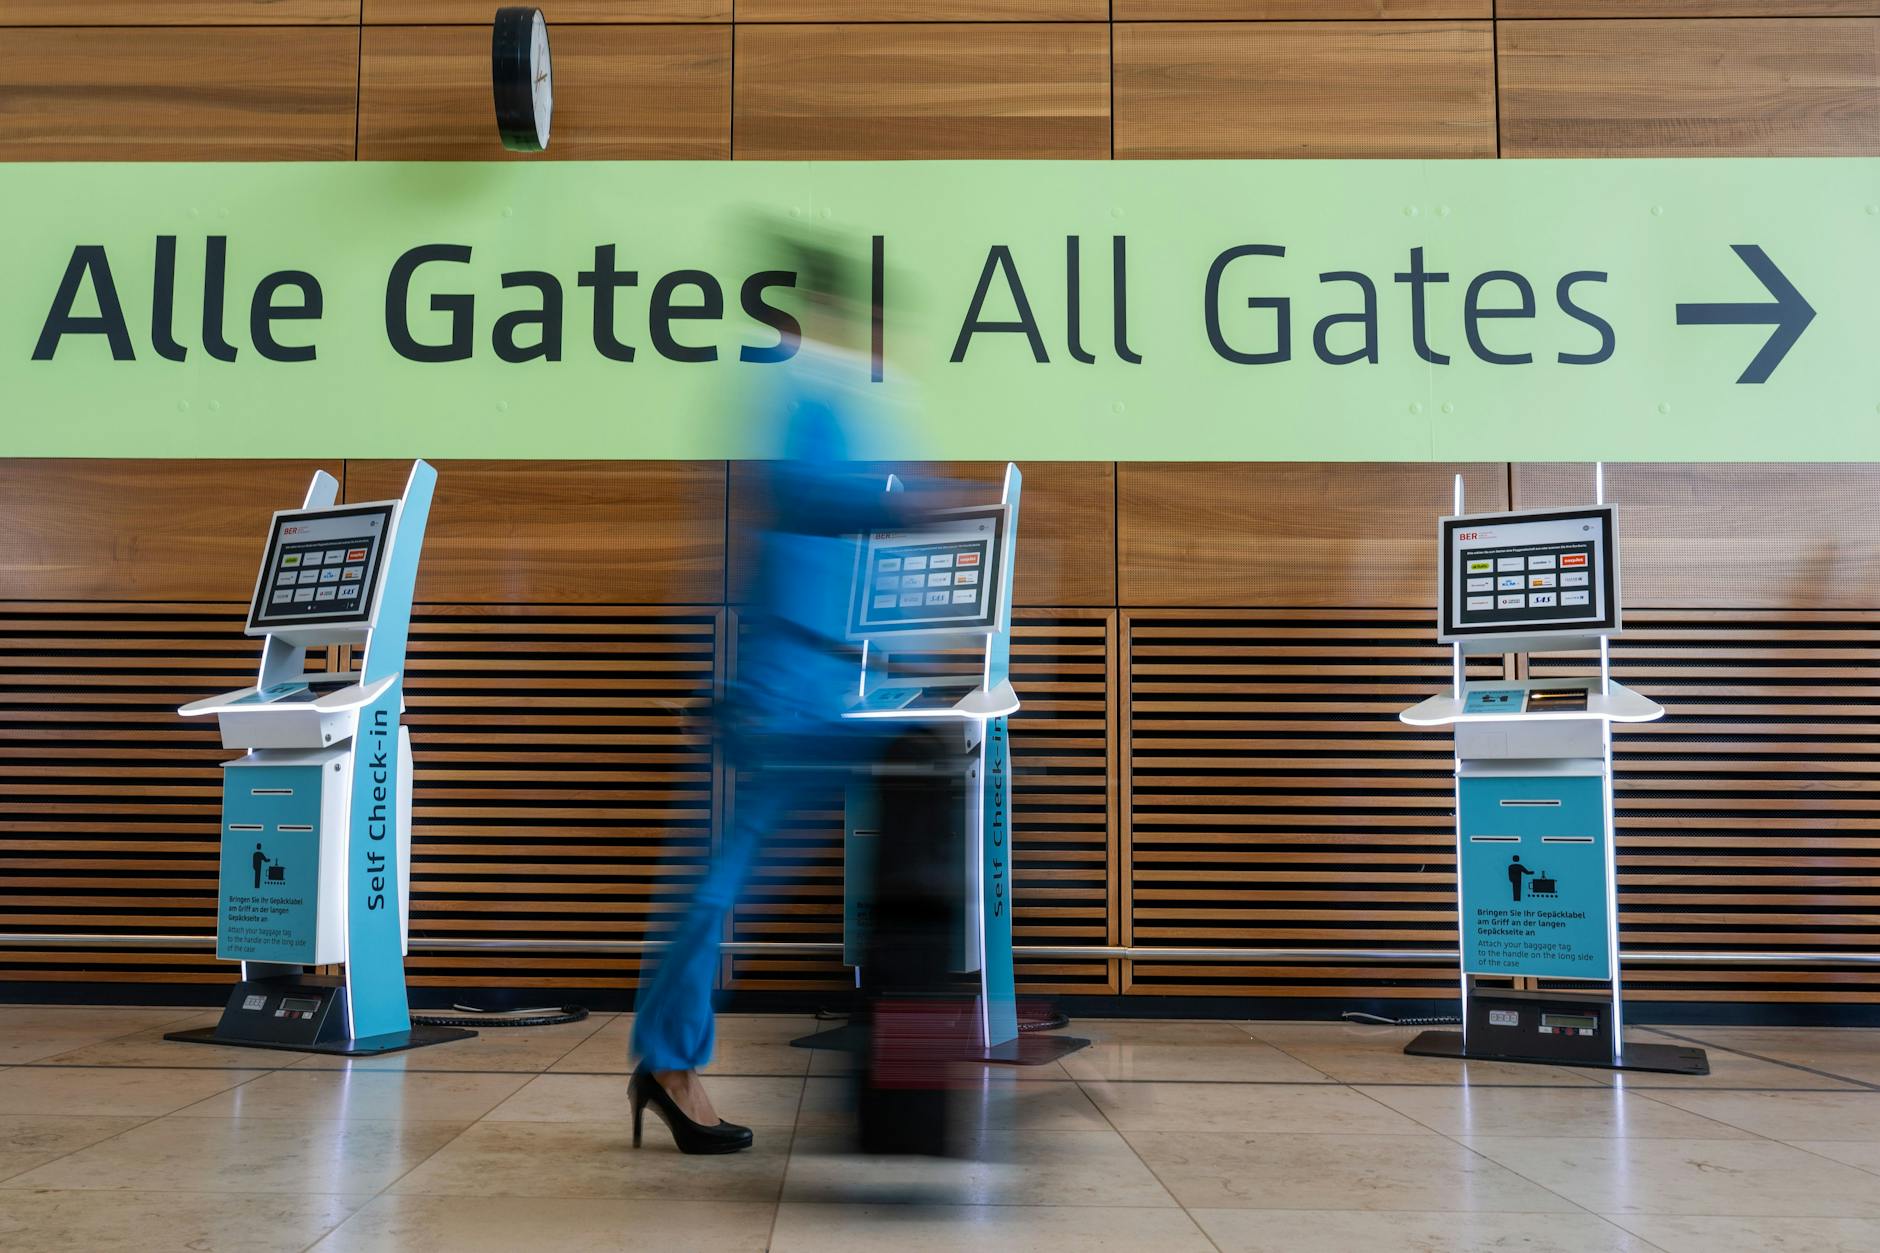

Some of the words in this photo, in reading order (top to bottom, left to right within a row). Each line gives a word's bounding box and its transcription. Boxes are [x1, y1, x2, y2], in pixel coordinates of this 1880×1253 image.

[31, 235, 323, 363] Alle
[385, 244, 798, 363] Gates
[950, 236, 1142, 364] All
[1205, 245, 1615, 365] Gates
[1460, 532, 1478, 541] BER
[368, 709, 388, 841] Check-in
[992, 717, 1003, 847] Check-in
[367, 851, 385, 910] Self
[993, 857, 1003, 918] Self
[270, 907, 288, 915] langen
[1478, 909, 1508, 917] Bringen
[1537, 910, 1585, 919] Gepäcklabel
[1538, 920, 1566, 928] langen
[1478, 928, 1523, 936] Gepäckseite
[1524, 941, 1556, 950] baggage
[1559, 943, 1571, 951] tag
[1502, 950, 1528, 958] handle
[1558, 953, 1575, 961] long
